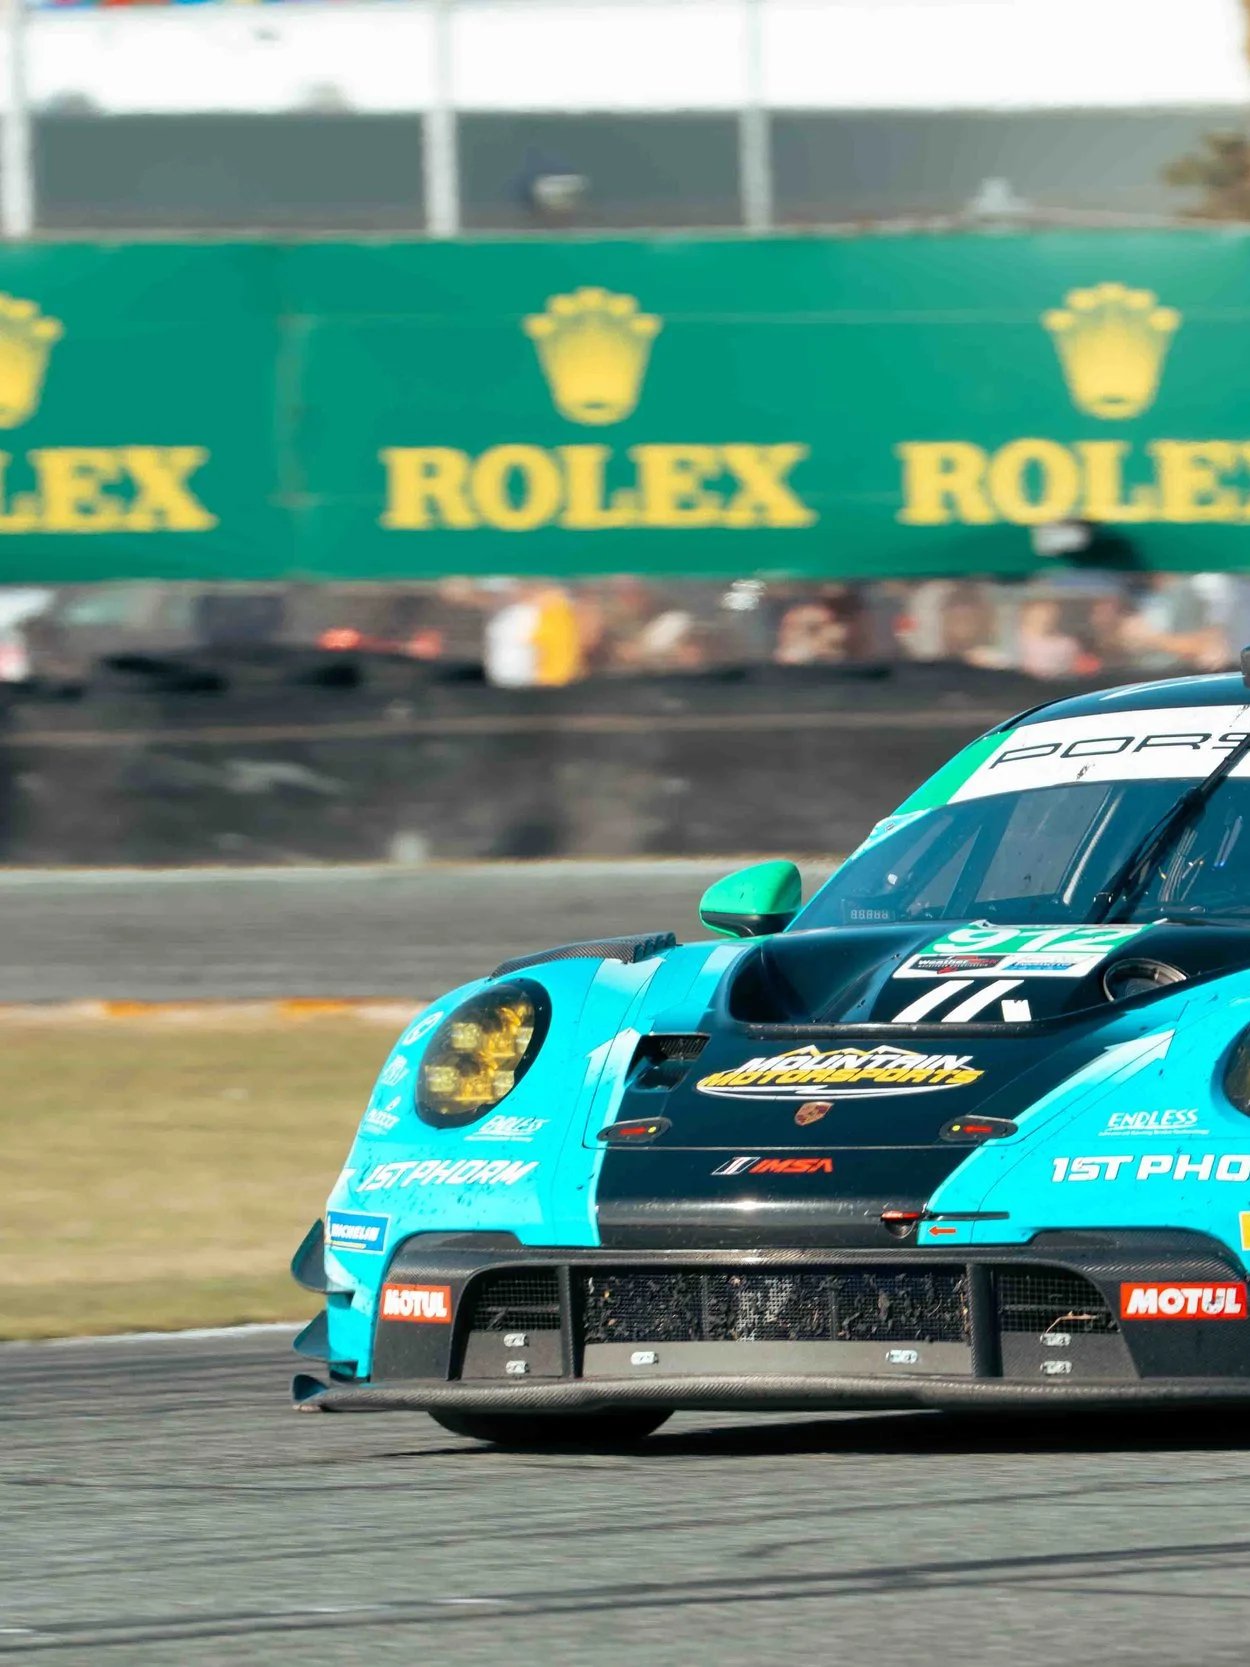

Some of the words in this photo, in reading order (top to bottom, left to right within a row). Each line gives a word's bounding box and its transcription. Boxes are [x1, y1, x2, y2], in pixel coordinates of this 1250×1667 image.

[381, 444, 816, 530] ROLEX
[931, 928, 1130, 952] 912
[734, 1055, 973, 1074] MOUNTAIN
[702, 1070, 984, 1086] MOTORSPORTS
[1106, 1109, 1198, 1127] ENDLESS
[399, 1160, 540, 1187] PHORM
[749, 1158, 833, 1174] IMSA
[1051, 1155, 1134, 1182] 1ST
[384, 1289, 448, 1319] MOTUL
[1126, 1287, 1242, 1315] MOTUL
